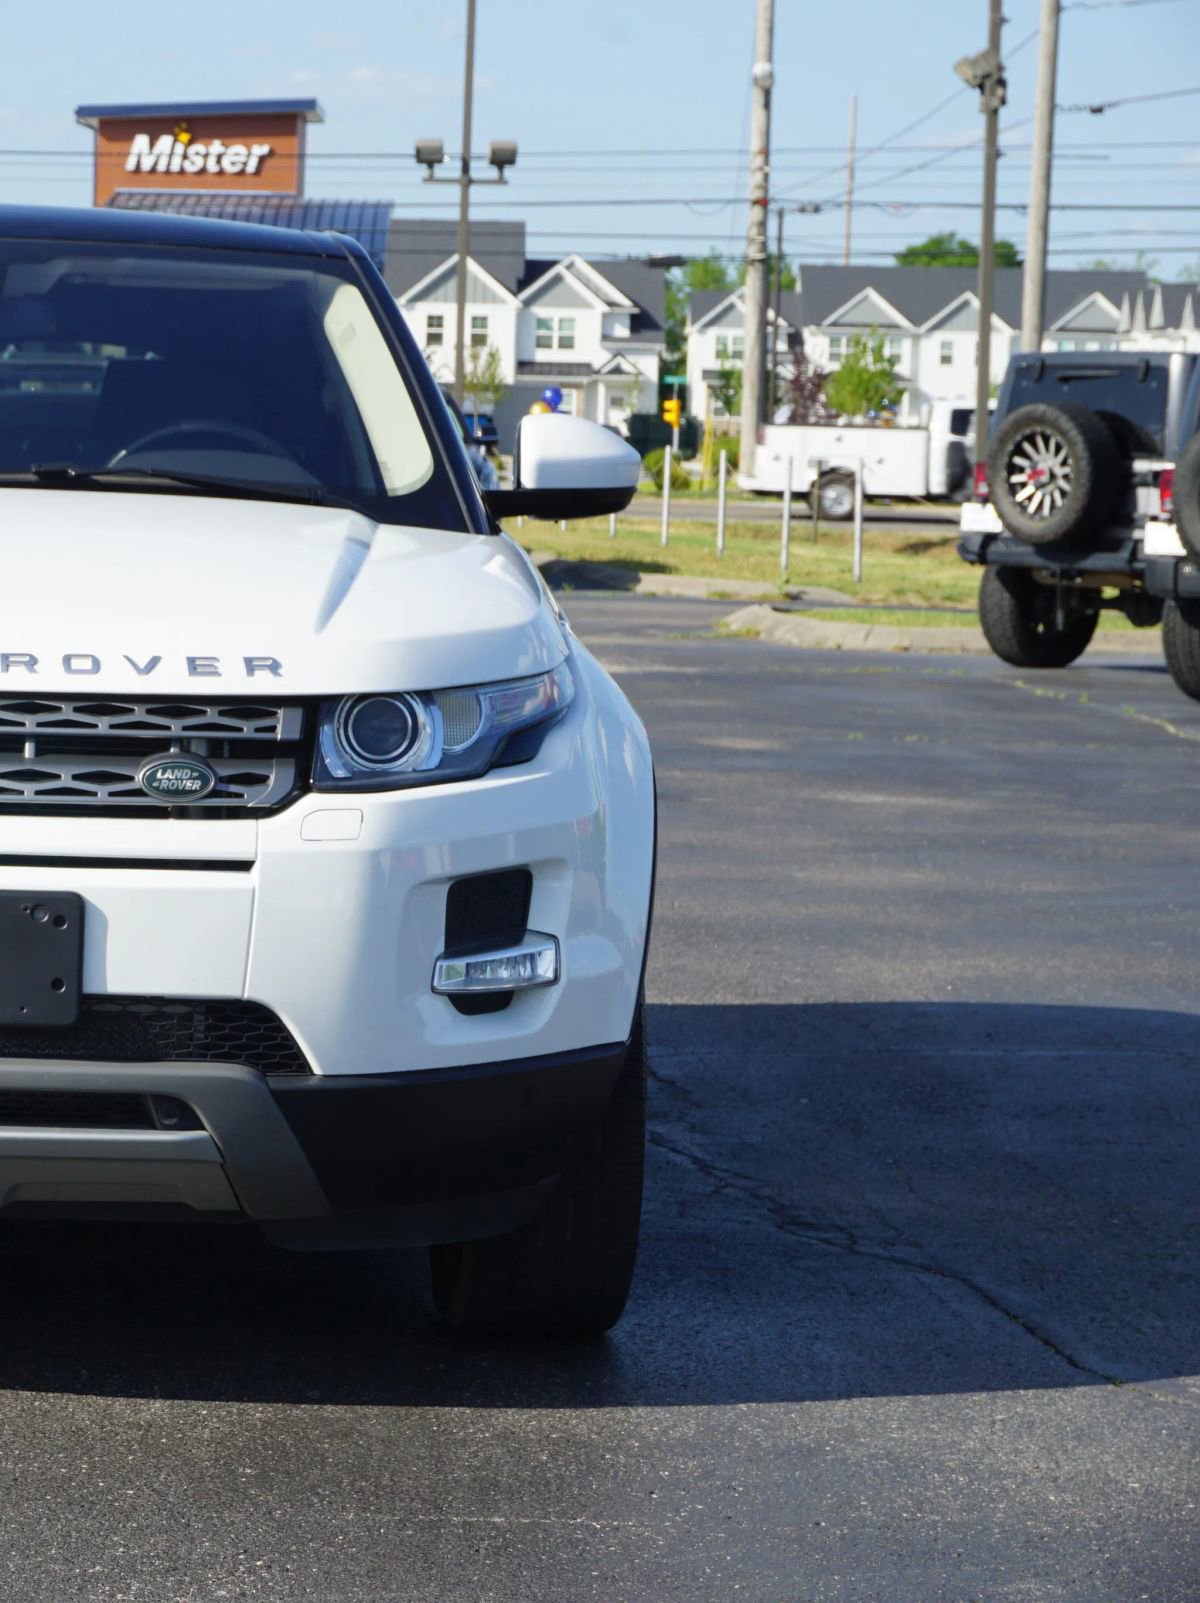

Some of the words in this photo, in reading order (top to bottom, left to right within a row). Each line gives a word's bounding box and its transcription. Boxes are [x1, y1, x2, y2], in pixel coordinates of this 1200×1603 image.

[124, 131, 272, 175] Mister
[0, 652, 285, 678] ROVER
[156, 768, 191, 780] LAND
[159, 779, 202, 790] ROVER
